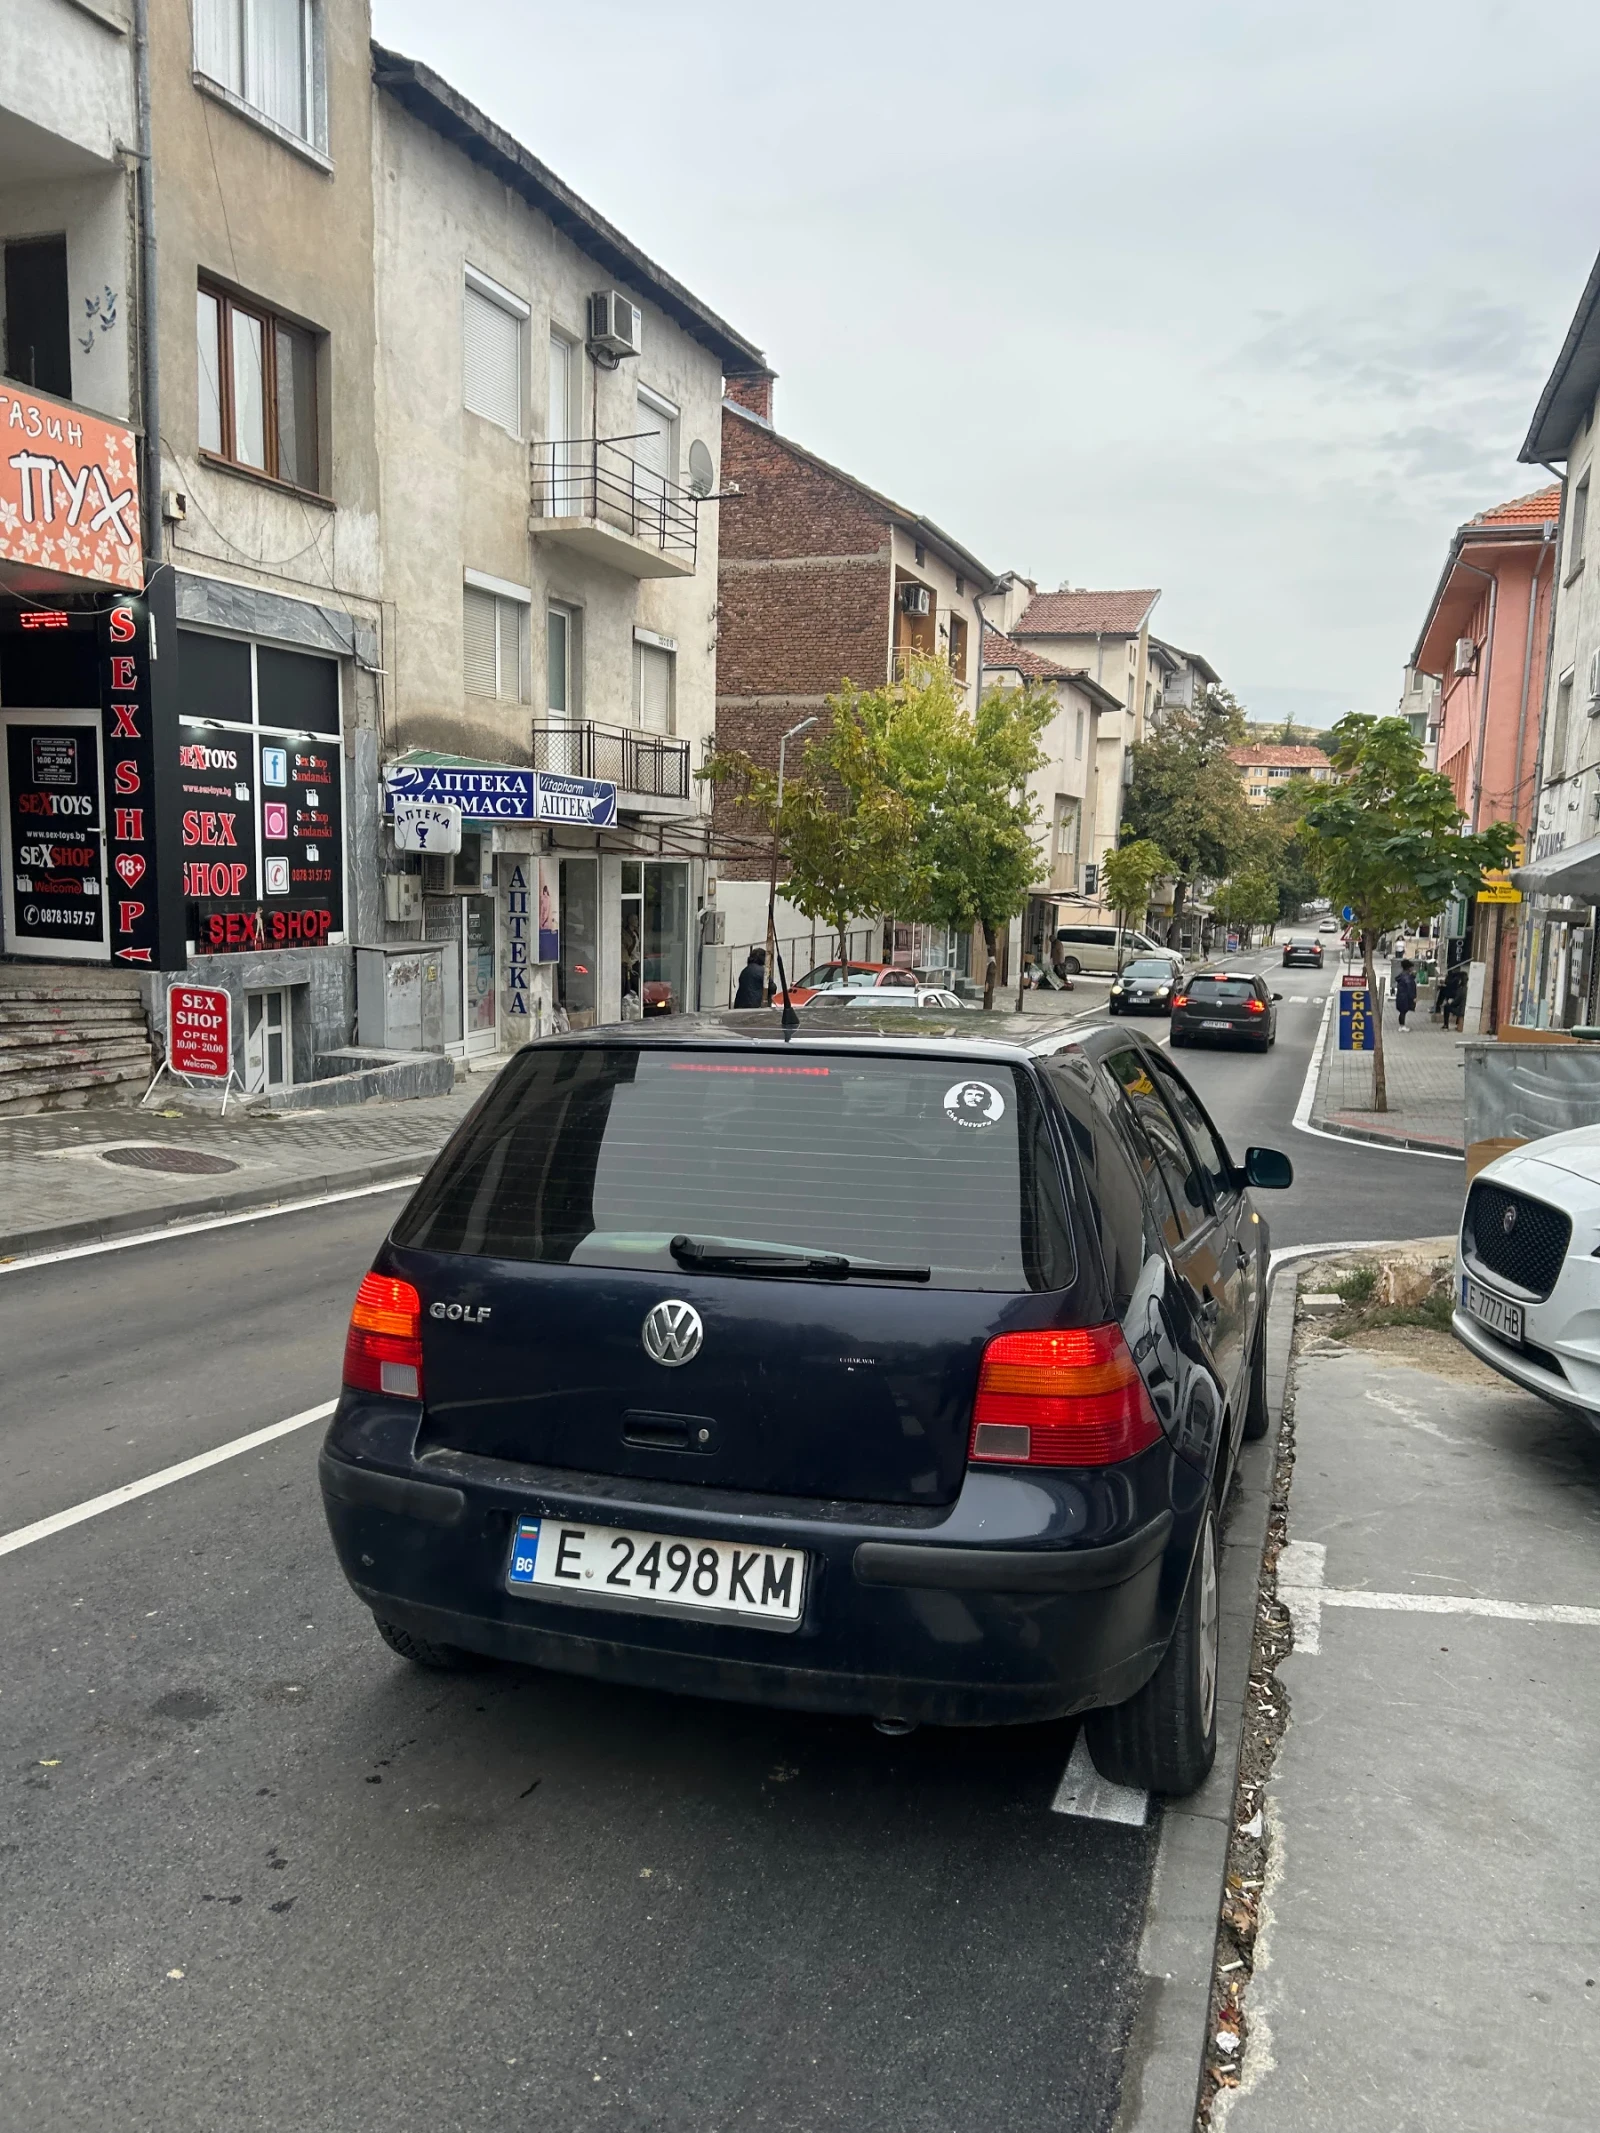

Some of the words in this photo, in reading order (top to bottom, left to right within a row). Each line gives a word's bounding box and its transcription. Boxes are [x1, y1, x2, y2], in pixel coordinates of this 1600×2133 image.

[8, 449, 134, 545] ПУХ
[110, 607, 140, 737] SEX
[295, 754, 309, 767] Sex
[309, 755, 328, 771] Shop
[291, 769, 332, 784] Sandanski
[427, 773, 528, 794] АПТЕКА
[540, 776, 584, 794] Vitapharm
[541, 794, 595, 820] АПТЕКА
[296, 809, 310, 822] Sex
[310, 810, 329, 824] Shop
[397, 809, 450, 830] АПТЕКА
[26, 830, 85, 842] www.sex-toys.bg
[183, 810, 238, 846] SEX
[293, 824, 332, 838] Sandanski
[118, 859, 142, 877] 18+
[34, 881, 82, 895] Welcome
[41, 908, 62, 924] 0878
[209, 912, 256, 944] SEX
[271, 909, 332, 939] SHOP
[508, 865, 528, 1014] АПТЕКА
[182, 994, 216, 1011] SEX
[175, 1011, 222, 1029] SHOP
[1351, 991, 1365, 1051] CHANGE
[183, 1031, 218, 1042] OPEN
[176, 1040, 197, 1050] 10.00
[202, 1042, 224, 1054] 20.00
[183, 1059, 217, 1070] Welcome
[429, 1302, 492, 1323] GOLF
[1479, 1292, 1502, 1326] 7777
[515, 1556, 533, 1573] BG
[554, 1529, 585, 1580] E
[606, 1536, 720, 1597] 2498
[728, 1550, 795, 1608] KM
